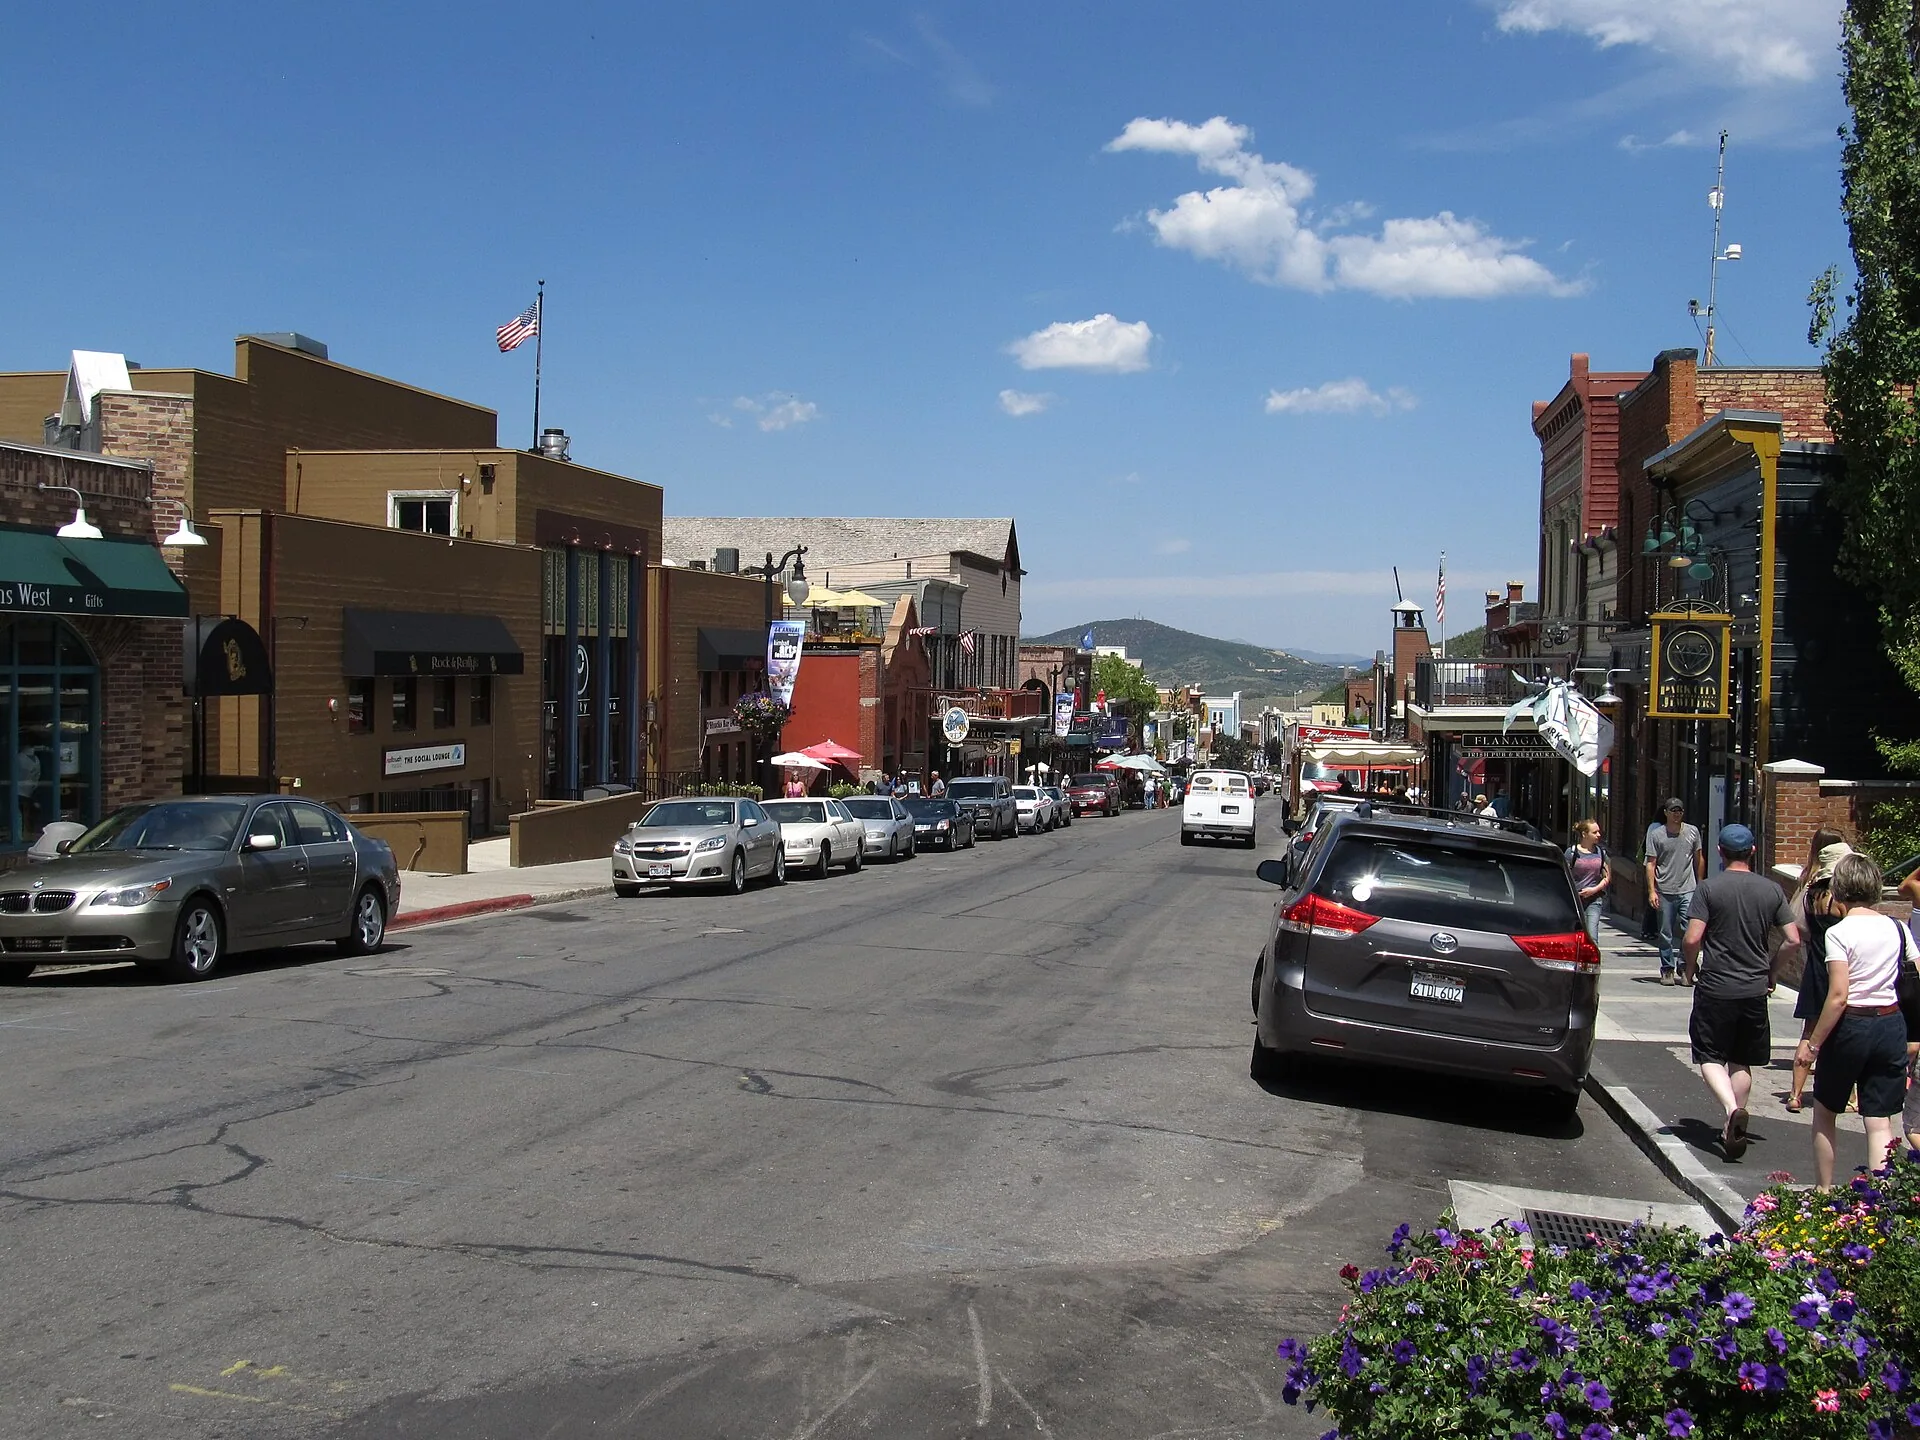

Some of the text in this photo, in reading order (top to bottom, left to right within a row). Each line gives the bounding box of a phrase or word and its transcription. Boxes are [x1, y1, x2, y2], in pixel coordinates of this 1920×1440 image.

[17, 583, 51, 606] West
[85, 594, 104, 607] Gifts
[1660, 685, 1716, 695] PARK CITY
[1661, 697, 1715, 707] JEWELERS
[1546, 726, 1563, 741] ARK
[404, 756, 413, 764] THE
[414, 754, 432, 763] SOCIAL
[432, 752, 450, 761] LOUNGE
[1413, 983, 1461, 1001] 6TDL602
